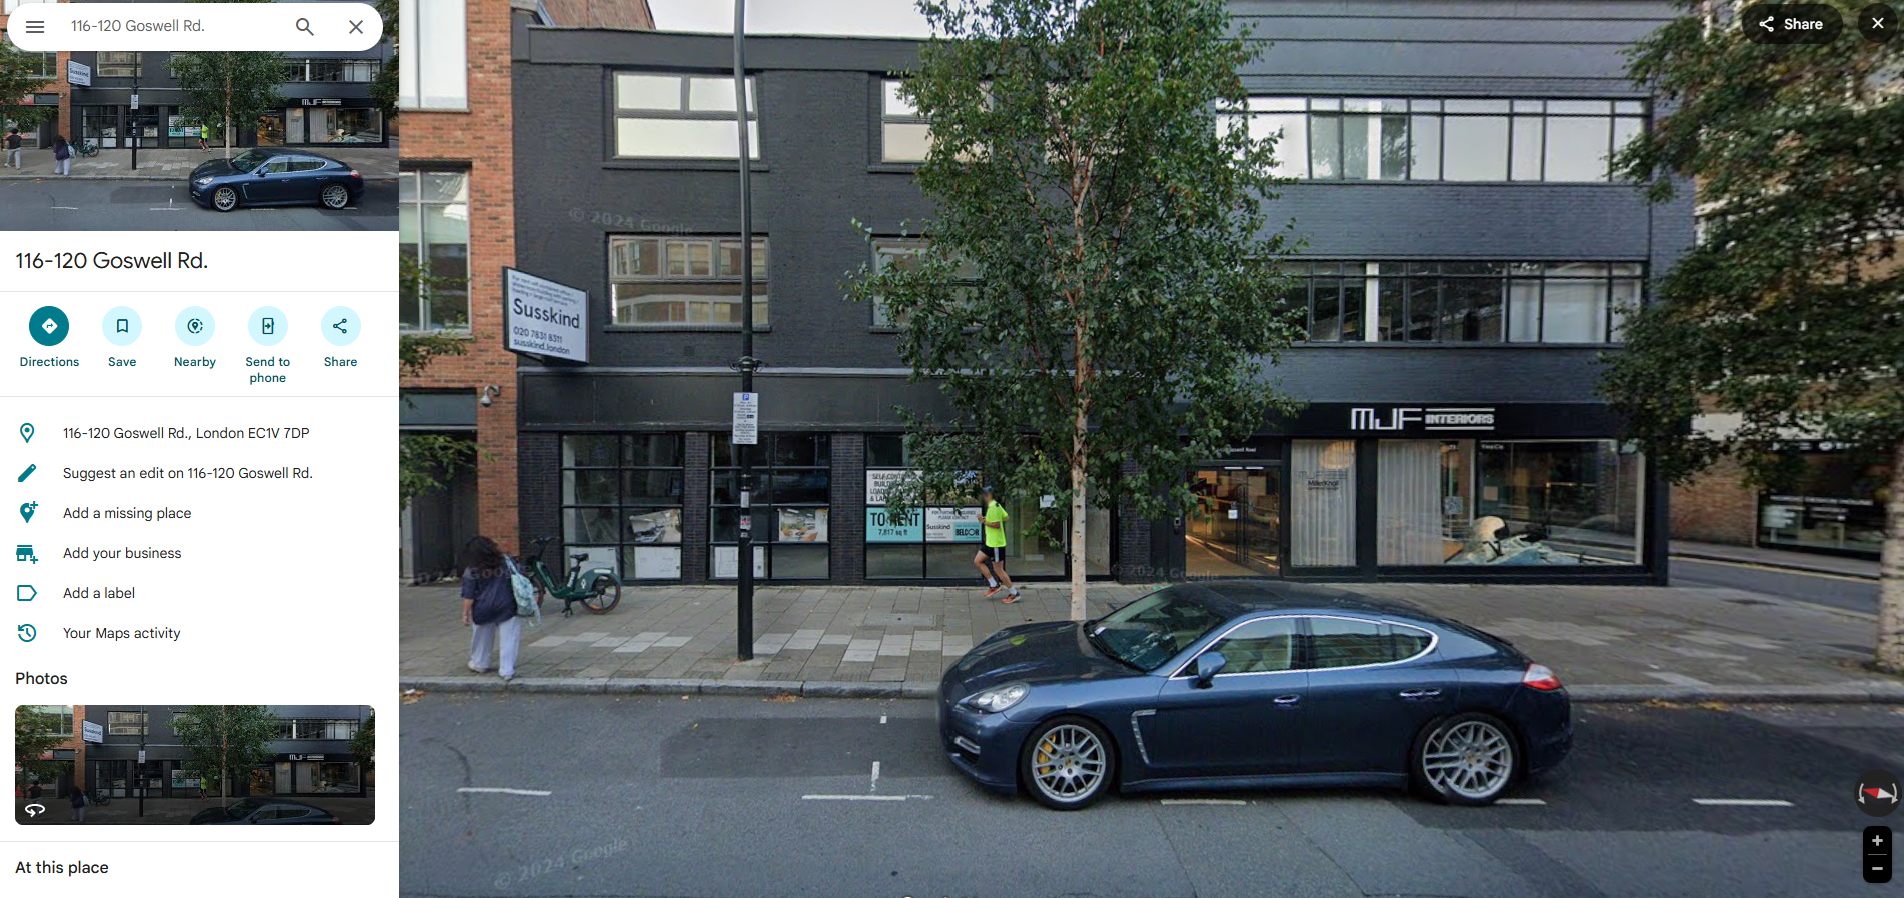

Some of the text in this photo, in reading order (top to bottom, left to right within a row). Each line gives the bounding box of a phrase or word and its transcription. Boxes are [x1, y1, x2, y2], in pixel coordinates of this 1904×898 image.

[71, 18, 205, 32] 116-120 Goswell Rd.
[1784, 17, 1824, 30] Share
[15, 251, 208, 270] 116-120 Goswell Rd.
[513, 297, 580, 330] Susskind
[513, 325, 529, 337] 020
[513, 339, 571, 354] susskind.london
[19, 355, 80, 367] Directions
[108, 356, 137, 367] Save
[174, 355, 217, 370] Nearby
[245, 355, 291, 367] Send to
[323, 355, 358, 367] Share
[249, 373, 287, 385] phone
[1350, 407, 1495, 431] MJF INTERIORS
[62, 426, 310, 441] 116-120 Goswell Rd., London EC1V 7DP
[62, 466, 313, 482] Suggest an edit on 116-120 Goswell Rd.
[62, 506, 192, 522] Add a missing place
[870, 512, 921, 527] TO ENT
[956, 528, 980, 536] BELCOR
[62, 546, 182, 562] Add your business
[62, 586, 135, 599] Add a label
[62, 626, 181, 642] Your Maps activity
[15, 670, 68, 685] Photos
[14, 859, 109, 878] At this place
